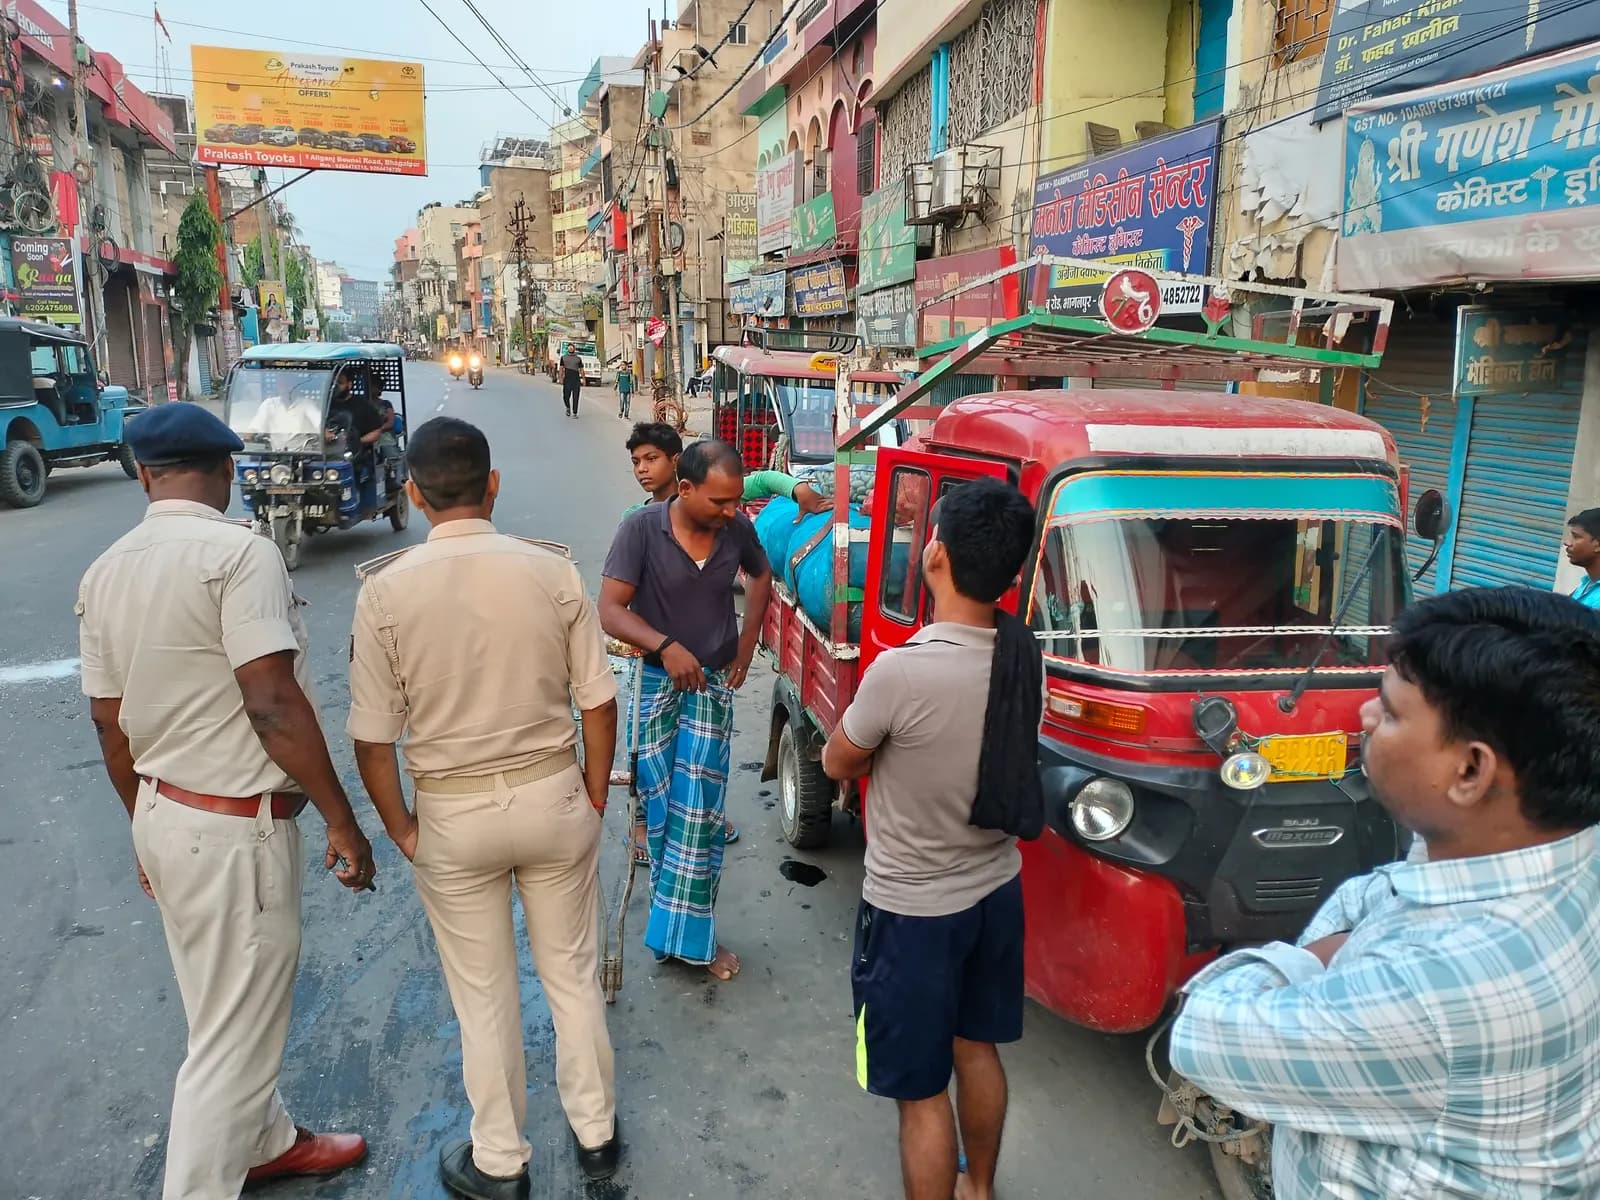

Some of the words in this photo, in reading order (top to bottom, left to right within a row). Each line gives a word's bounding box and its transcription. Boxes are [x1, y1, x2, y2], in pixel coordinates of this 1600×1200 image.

[17, 10, 55, 52] HONDA
[1337, 35, 1358, 52] Dr.
[1362, 9, 1412, 41] Fahad
[1335, 53, 1354, 75] डॉ.
[1401, 13, 1461, 49] खलील
[290, 62, 317, 70] Prakash
[318, 64, 339, 72] Toyota
[298, 89, 331, 98] OFFERS!
[1354, 115, 1376, 133] GST
[1386, 120, 1428, 184] श्री
[1434, 103, 1541, 173] गणेश
[203, 148, 252, 161] Prakash
[255, 151, 295, 164] Toyota
[727, 193, 757, 214] आयुष
[1034, 187, 1076, 238] मनोज
[1077, 167, 1146, 228] मेडिसीन
[1149, 156, 1212, 218] सेन्टर
[1435, 176, 1530, 213] केमिस्ट
[727, 212, 757, 236] मेडिकल
[13, 240, 48, 255] Coming
[27, 253, 44, 261] Soon
[1062, 295, 1092, 314] भागलपुर
[1282, 818, 1320, 827] BAJAJ
[1265, 831, 1336, 842] Maxima
